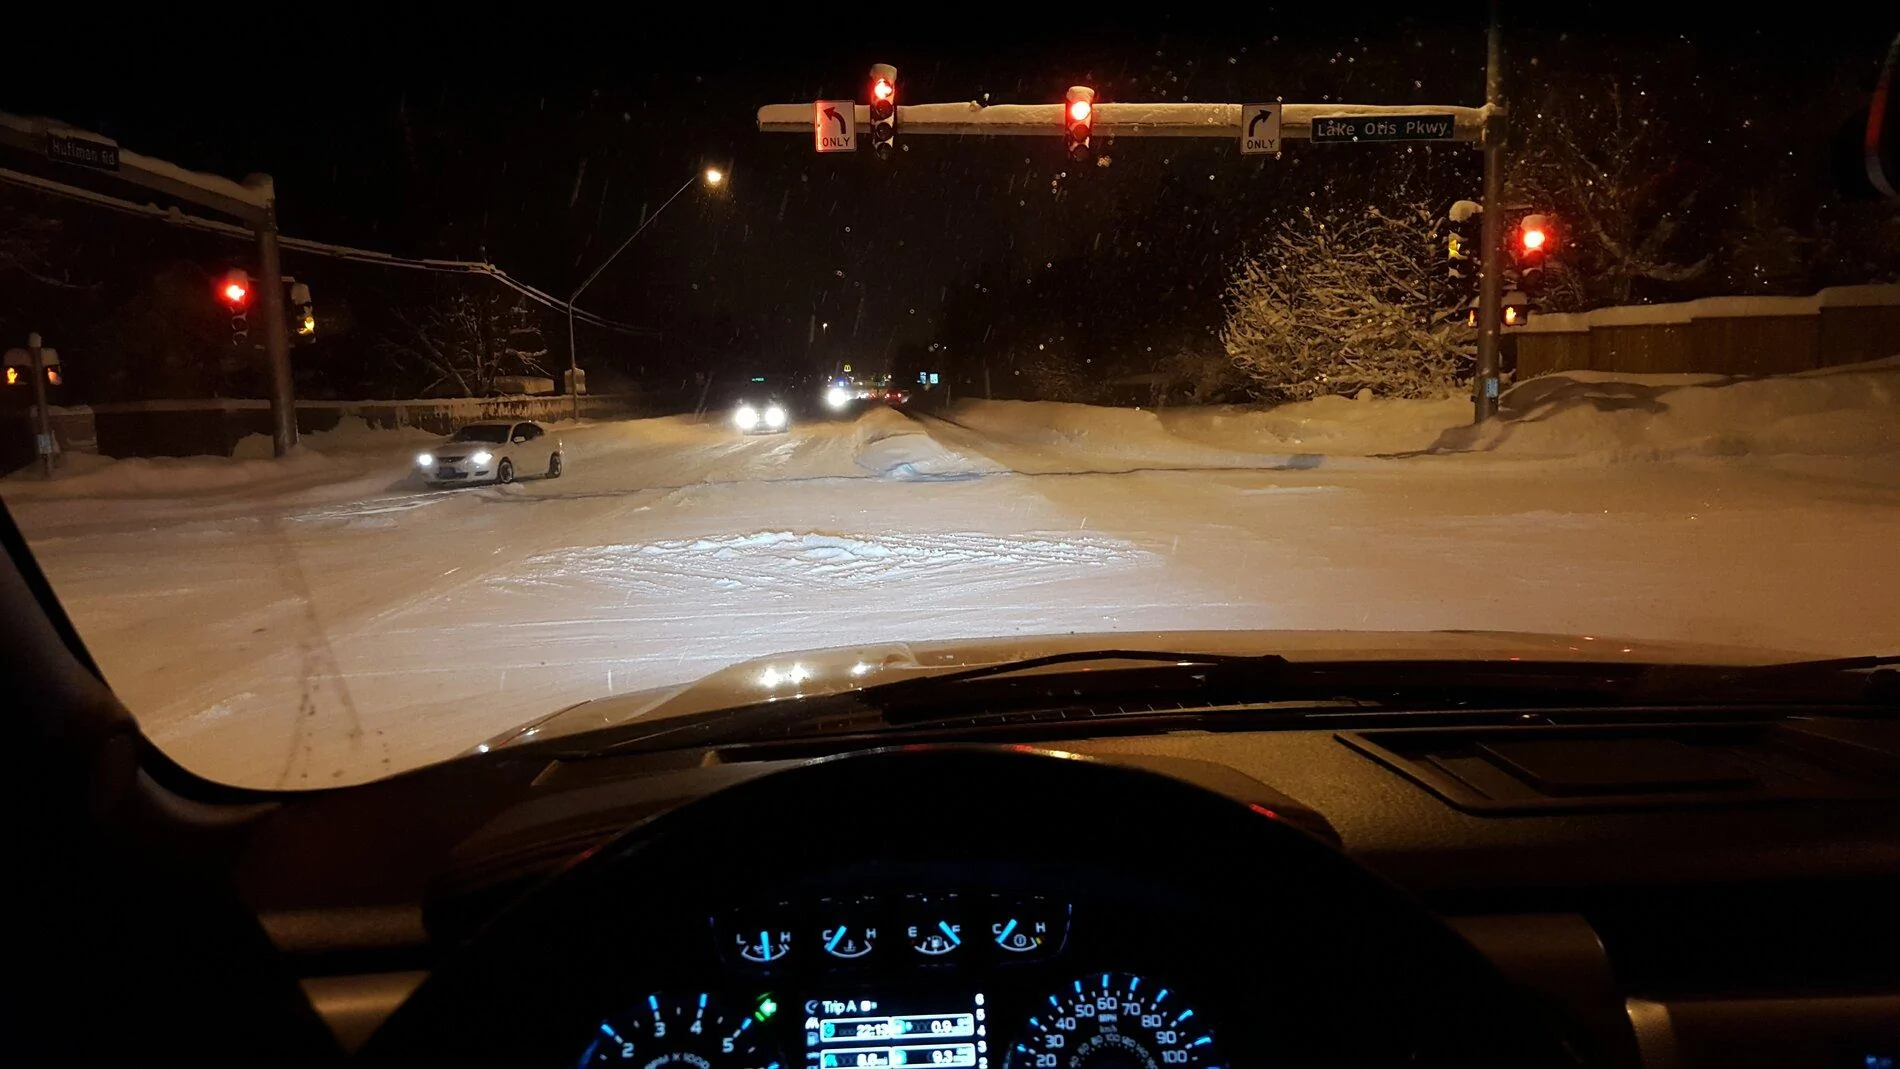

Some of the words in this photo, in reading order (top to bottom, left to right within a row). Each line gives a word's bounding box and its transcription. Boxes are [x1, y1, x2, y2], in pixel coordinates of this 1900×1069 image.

[1318, 123, 1355, 136] Lake
[1365, 122, 1397, 135] Otis
[1406, 121, 1448, 137] Pkwy
[822, 137, 850, 147] ONLY
[1246, 139, 1276, 150] ONLY
[102, 150, 115, 165] Rd
[866, 928, 876, 939] H
[908, 926, 917, 937] E
[992, 924, 1001, 935] C
[1035, 922, 1046, 933] H
[736, 934, 745, 945] L
[780, 931, 791, 943] H
[822, 930, 832, 941] C
[822, 1000, 845, 1015] Trip
[846, 1000, 857, 1012] A
[1097, 997, 1117, 1010] 60
[1121, 1002, 1141, 1016] 70
[1075, 1004, 1095, 1018] 50
[690, 1020, 703, 1035] 4
[1055, 1017, 1076, 1031] 40
[1141, 1014, 1162, 1028] 80
[654, 1022, 666, 1037] 3
[1045, 1035, 1064, 1048] 30
[1156, 1031, 1177, 1044] 90
[622, 1043, 634, 1058] 2
[722, 1037, 734, 1053] 5
[978, 1040, 987, 1053] 3
[1036, 1054, 1057, 1068] 20
[1162, 1050, 1187, 1063] 100
